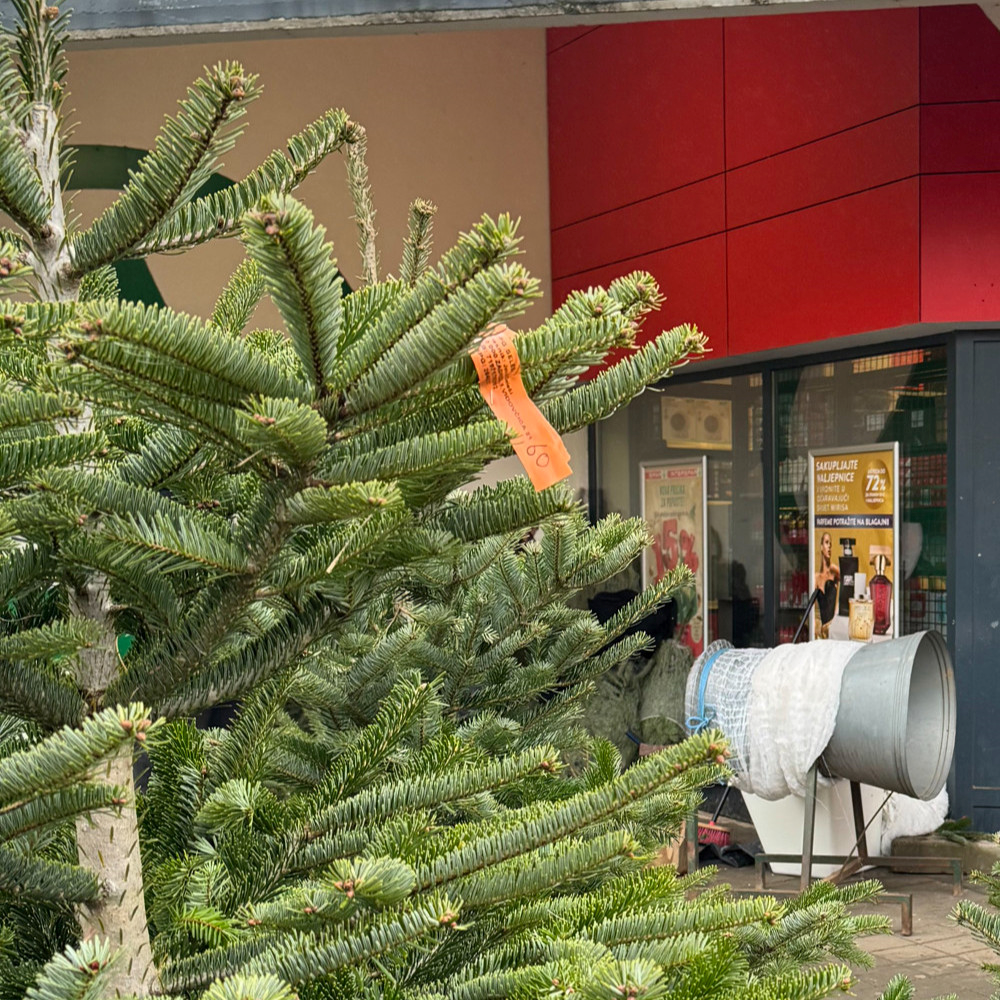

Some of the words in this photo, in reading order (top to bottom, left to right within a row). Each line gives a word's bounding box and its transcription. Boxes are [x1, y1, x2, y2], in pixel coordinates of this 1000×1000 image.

[526, 444, 550, 468] 60
[816, 460, 859, 471] SAKUPLJAJTE
[816, 472, 855, 483] NALJEPNICE
[865, 474, 886, 492] 72%
[833, 516, 857, 526] POTRAŽITE
[857, 517, 865, 526] NA
